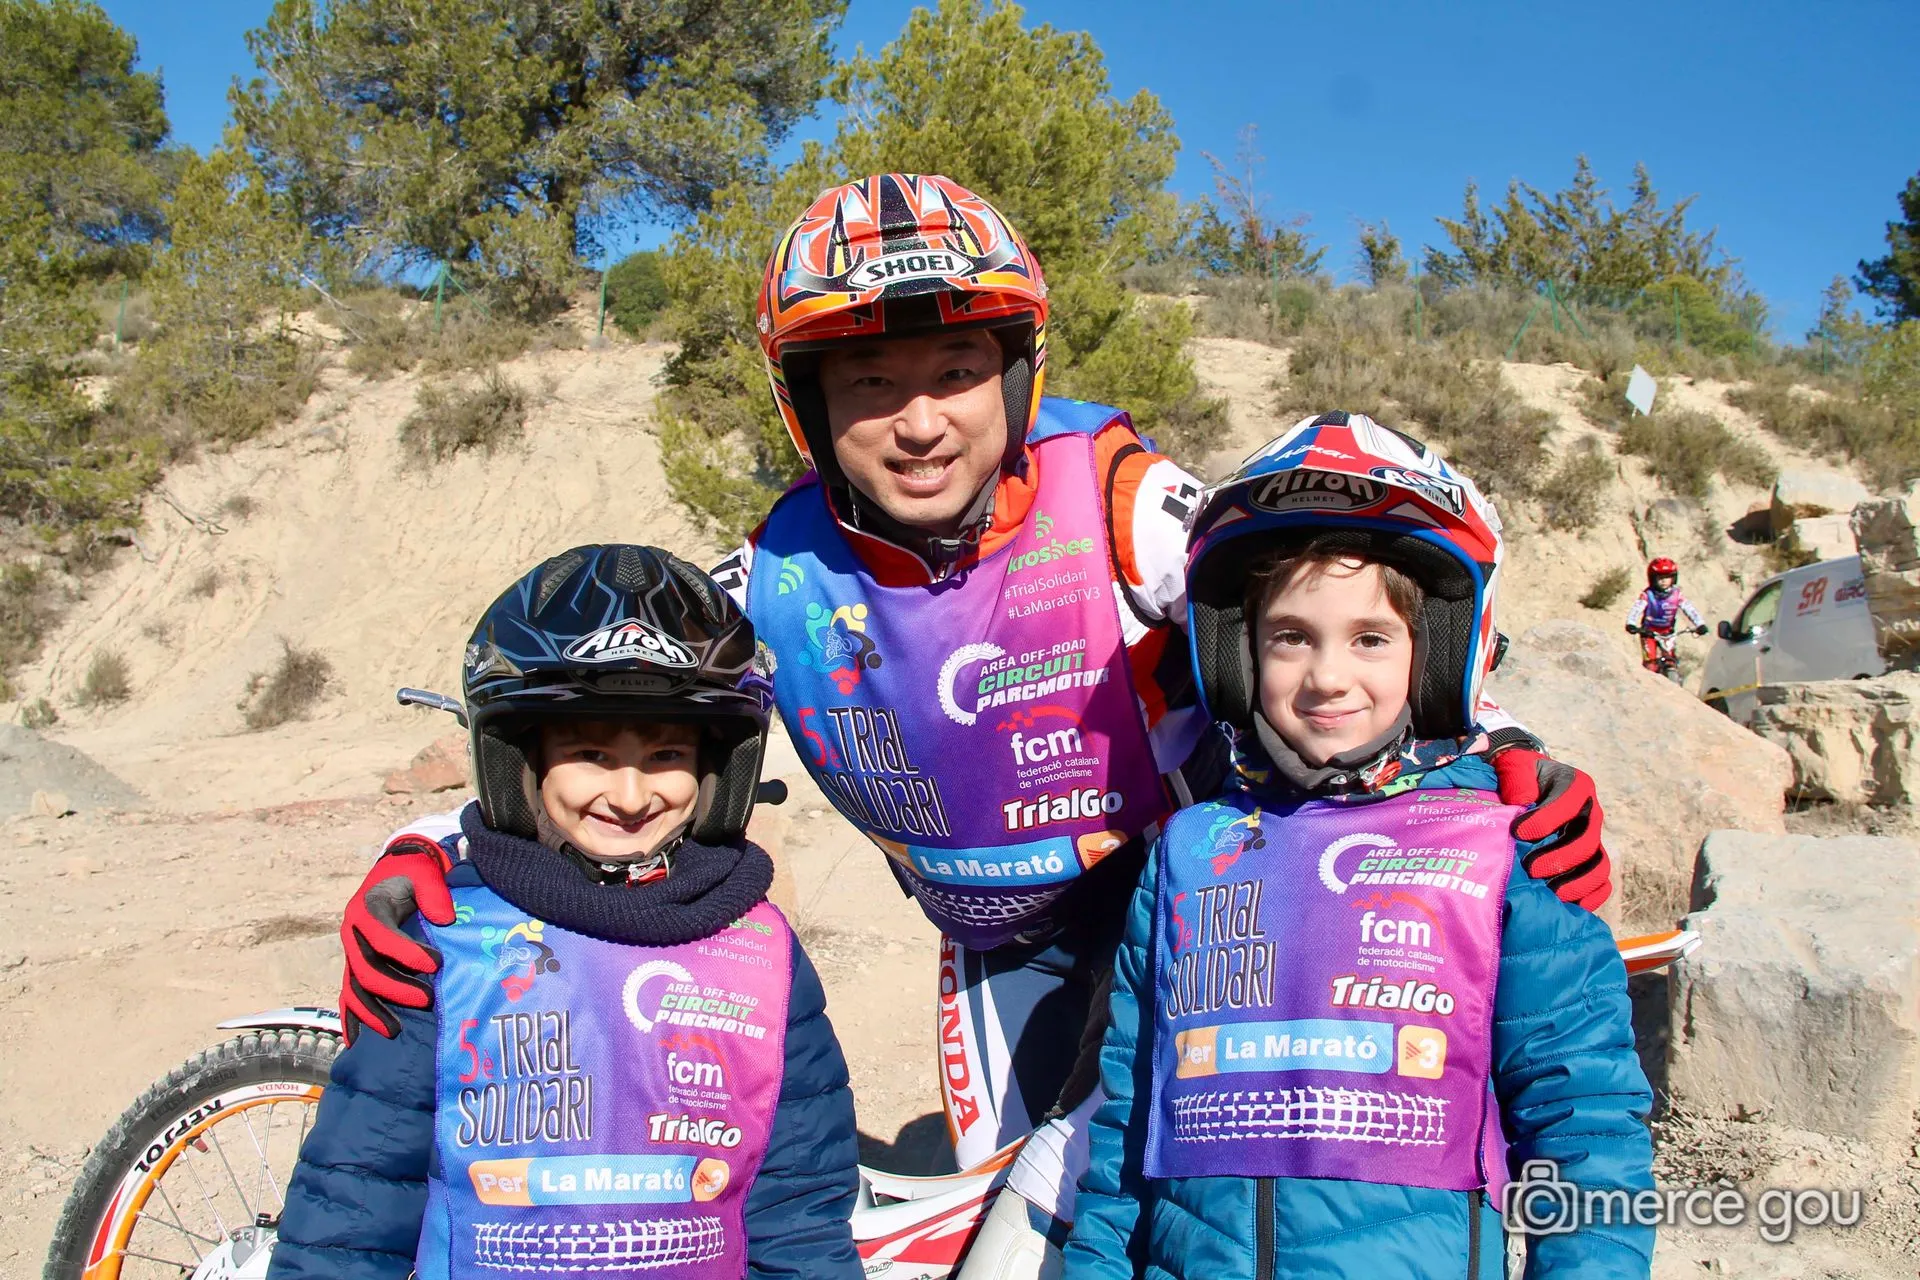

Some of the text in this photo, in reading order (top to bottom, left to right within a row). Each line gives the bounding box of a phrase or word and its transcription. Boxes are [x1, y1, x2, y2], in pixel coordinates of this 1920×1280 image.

[866, 255, 955, 283] SHOEI
[1004, 567, 1088, 601] #TrialSolidari
[1007, 586, 1101, 620] #LaMaratóTV3
[572, 624, 689, 663] Airoh
[611, 647, 655, 657] HELMET
[979, 638, 1086, 678] AREA OFF-ROAD
[978, 652, 1086, 694] CIRCUIT
[976, 667, 1110, 713] PARCMOTOR
[1010, 727, 1083, 766] fcm
[1016, 756, 1100, 779] federació catalana
[1019, 768, 1093, 790] de motociclisme
[1003, 788, 1124, 831] TrialGo
[919, 850, 1065, 878] La Marató
[1358, 857, 1475, 875] CIRCUIT
[1365, 847, 1479, 861] AREA OFF-ROAD
[1348, 871, 1490, 900] PARCMOTOR
[1359, 911, 1431, 948] fcm
[697, 945, 774, 970] #LaMaratóTV3
[1357, 957, 1436, 973] de motociclisme
[1358, 947, 1445, 965] federació catalana
[660, 993, 755, 1020] CIRCUIT
[665, 982, 760, 1007] AREA OFF-ROAD
[1330, 977, 1455, 1016] TrialGo
[654, 1009, 767, 1040] PARCMOTOR
[940, 931, 980, 1137] HONDA
[1224, 1037, 1261, 1061] La
[1263, 1033, 1378, 1061] Marató
[666, 1051, 723, 1088] fcm
[257, 1083, 300, 1092] HONDA
[668, 1095, 680, 1104] de
[134, 1099, 225, 1173] REPSOL
[648, 1114, 742, 1148] TrialGo
[477, 1173, 523, 1193] Per
[541, 1168, 577, 1192] La
[583, 1166, 685, 1192] Marató
